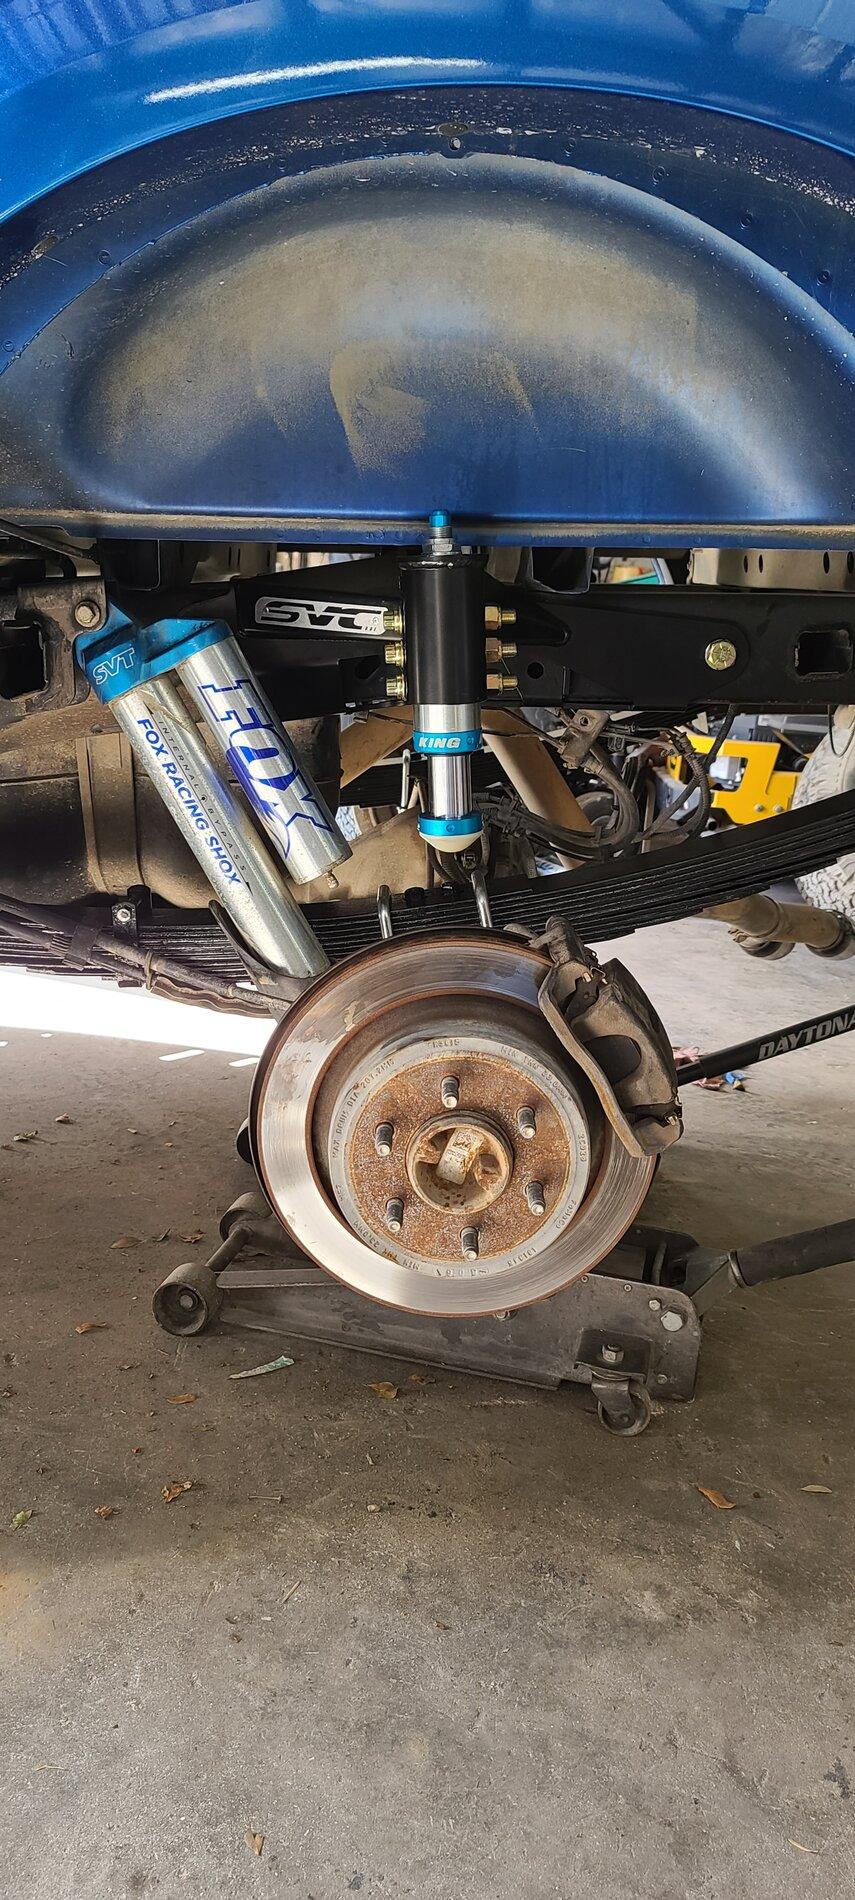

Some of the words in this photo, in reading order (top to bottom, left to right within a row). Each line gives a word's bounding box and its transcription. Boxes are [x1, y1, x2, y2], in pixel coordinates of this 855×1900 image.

[93, 647, 135, 685] SVT
[137, 719, 169, 757] FOX
[162, 762, 210, 831] RACING
[206, 836, 241, 885] SHOX
[158, 721, 199, 789] INTERNAL
[207, 808, 247, 871] BYPASS
[197, 679, 335, 834] FOX
[418, 737, 461, 749] KING
